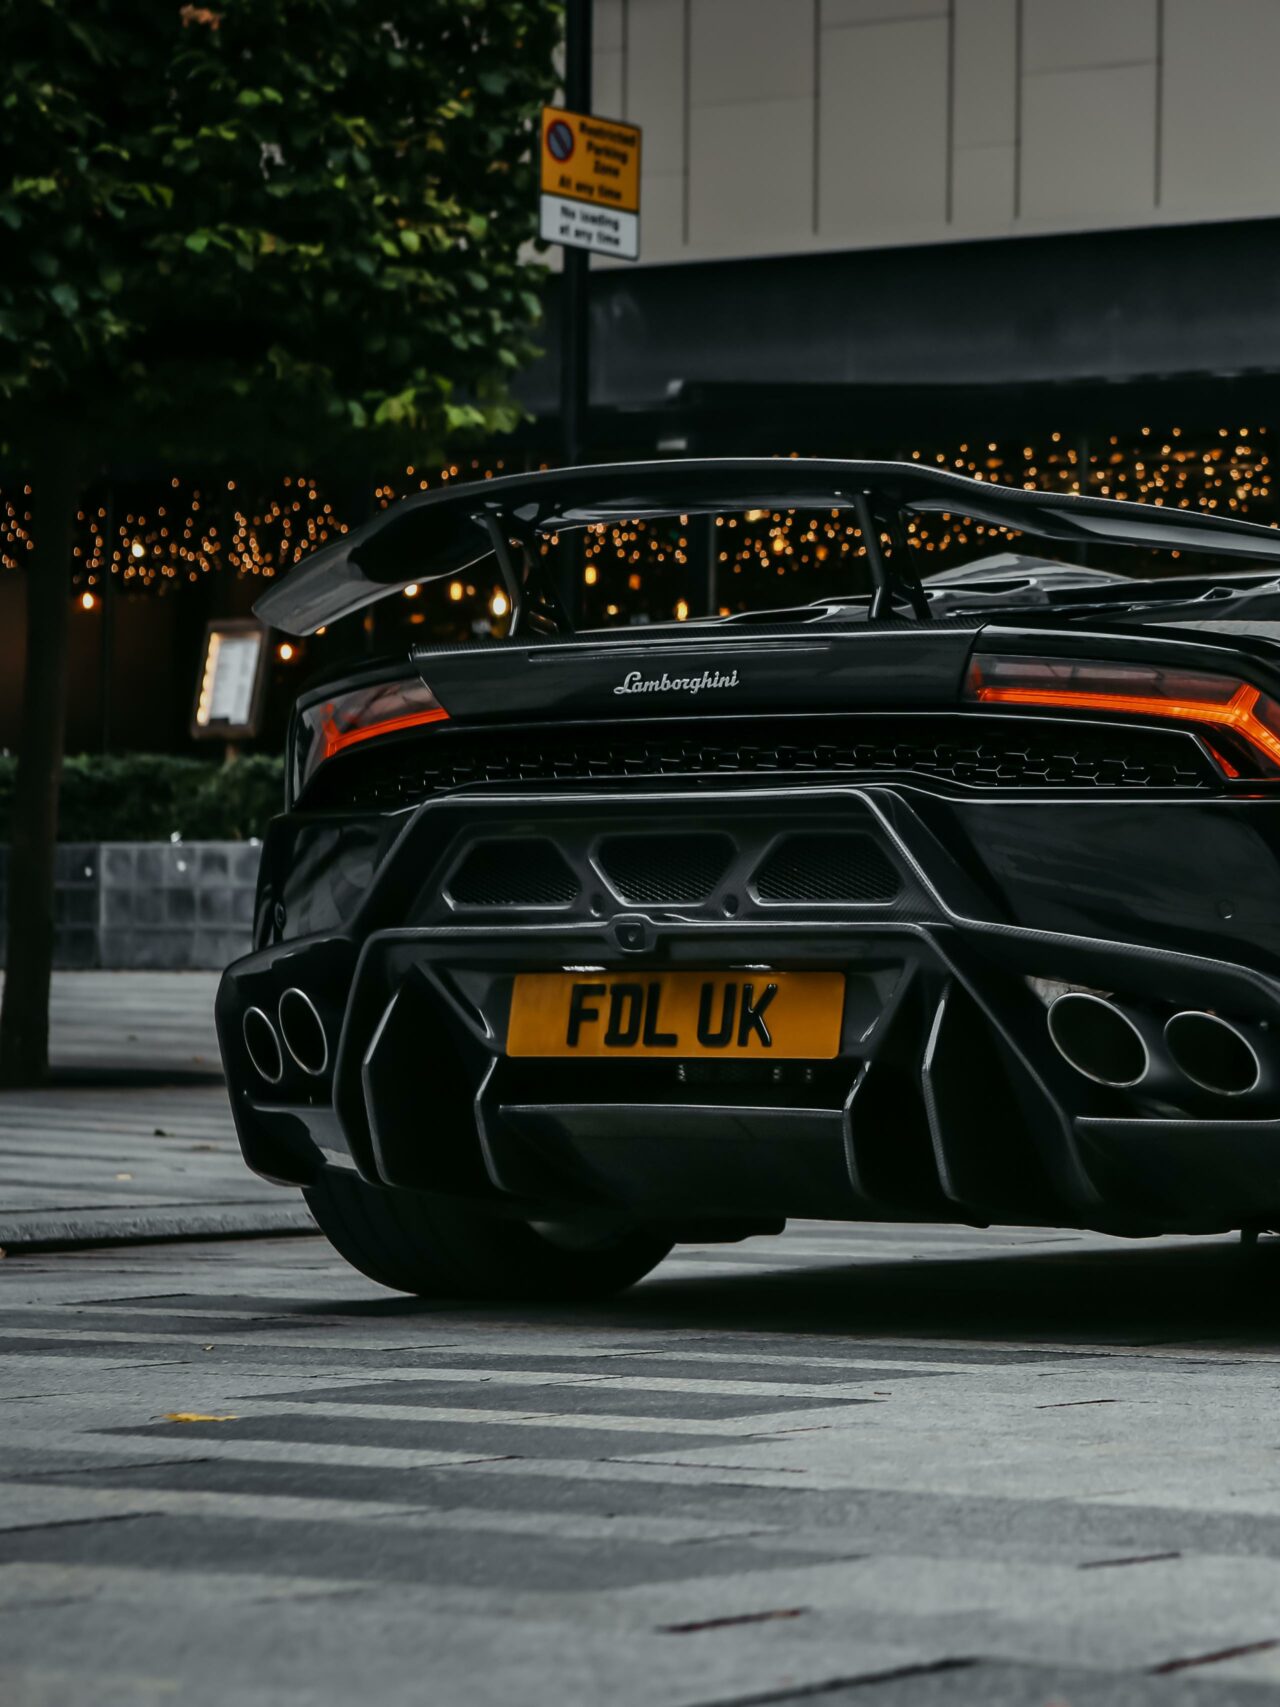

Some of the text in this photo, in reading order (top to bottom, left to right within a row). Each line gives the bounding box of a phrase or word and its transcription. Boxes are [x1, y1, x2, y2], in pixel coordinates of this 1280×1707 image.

[561, 206, 620, 232] No loading
[560, 224, 620, 246] at any time
[613, 670, 739, 694] Lamborghini
[566, 983, 777, 1047] FDL UK
